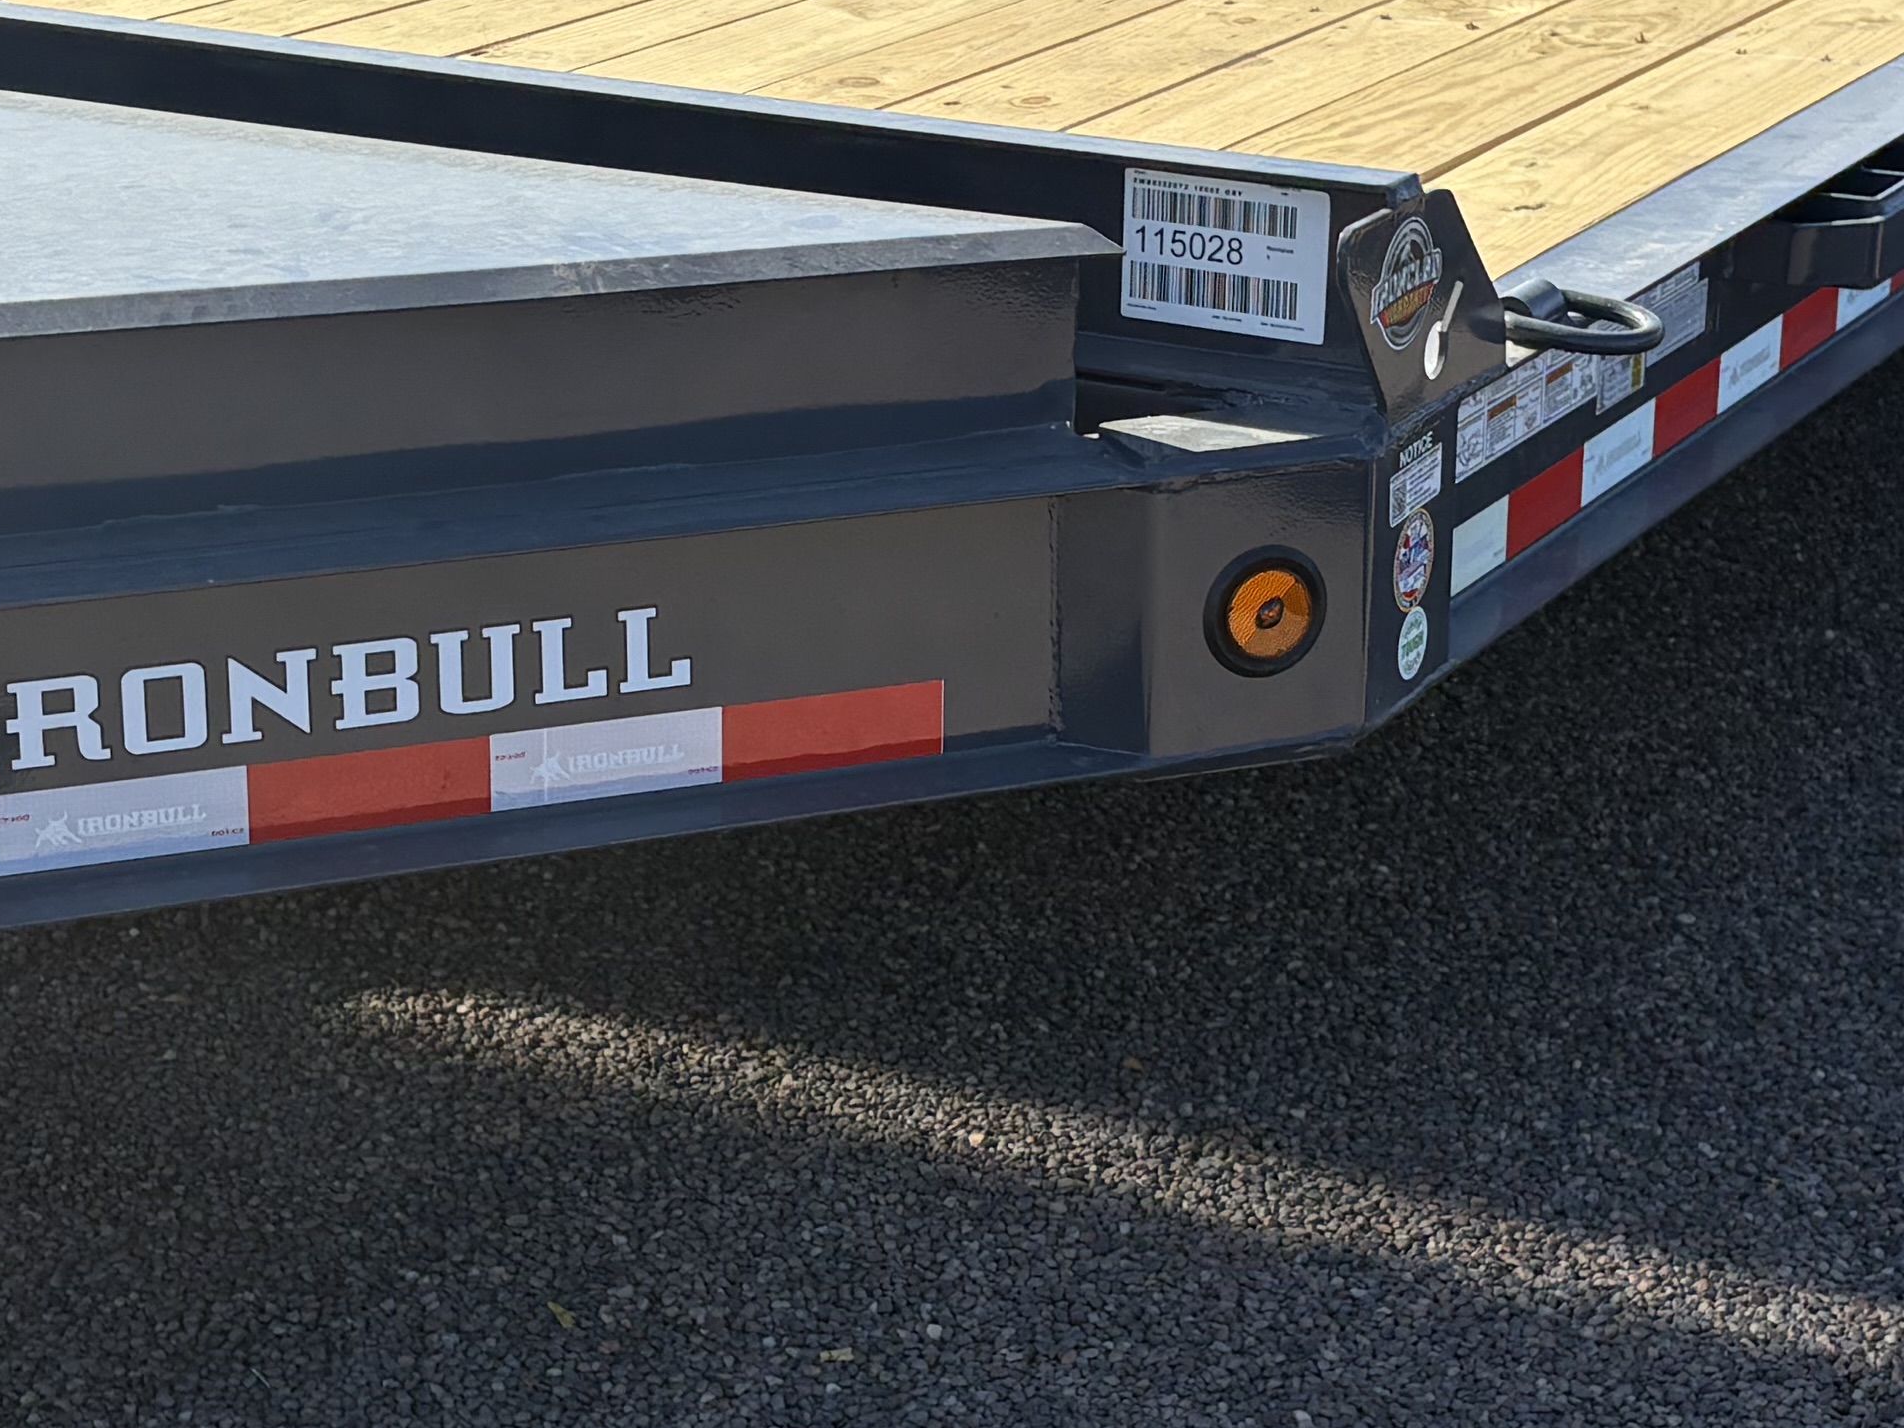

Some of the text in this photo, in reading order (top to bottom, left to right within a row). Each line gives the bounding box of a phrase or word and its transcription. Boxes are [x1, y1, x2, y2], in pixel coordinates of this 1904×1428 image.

[1135, 225, 1244, 265] 115028
[1400, 431, 1433, 468] NOTICE
[568, 743, 684, 773] IRONBULL
[77, 803, 207, 837] IRONBULL
